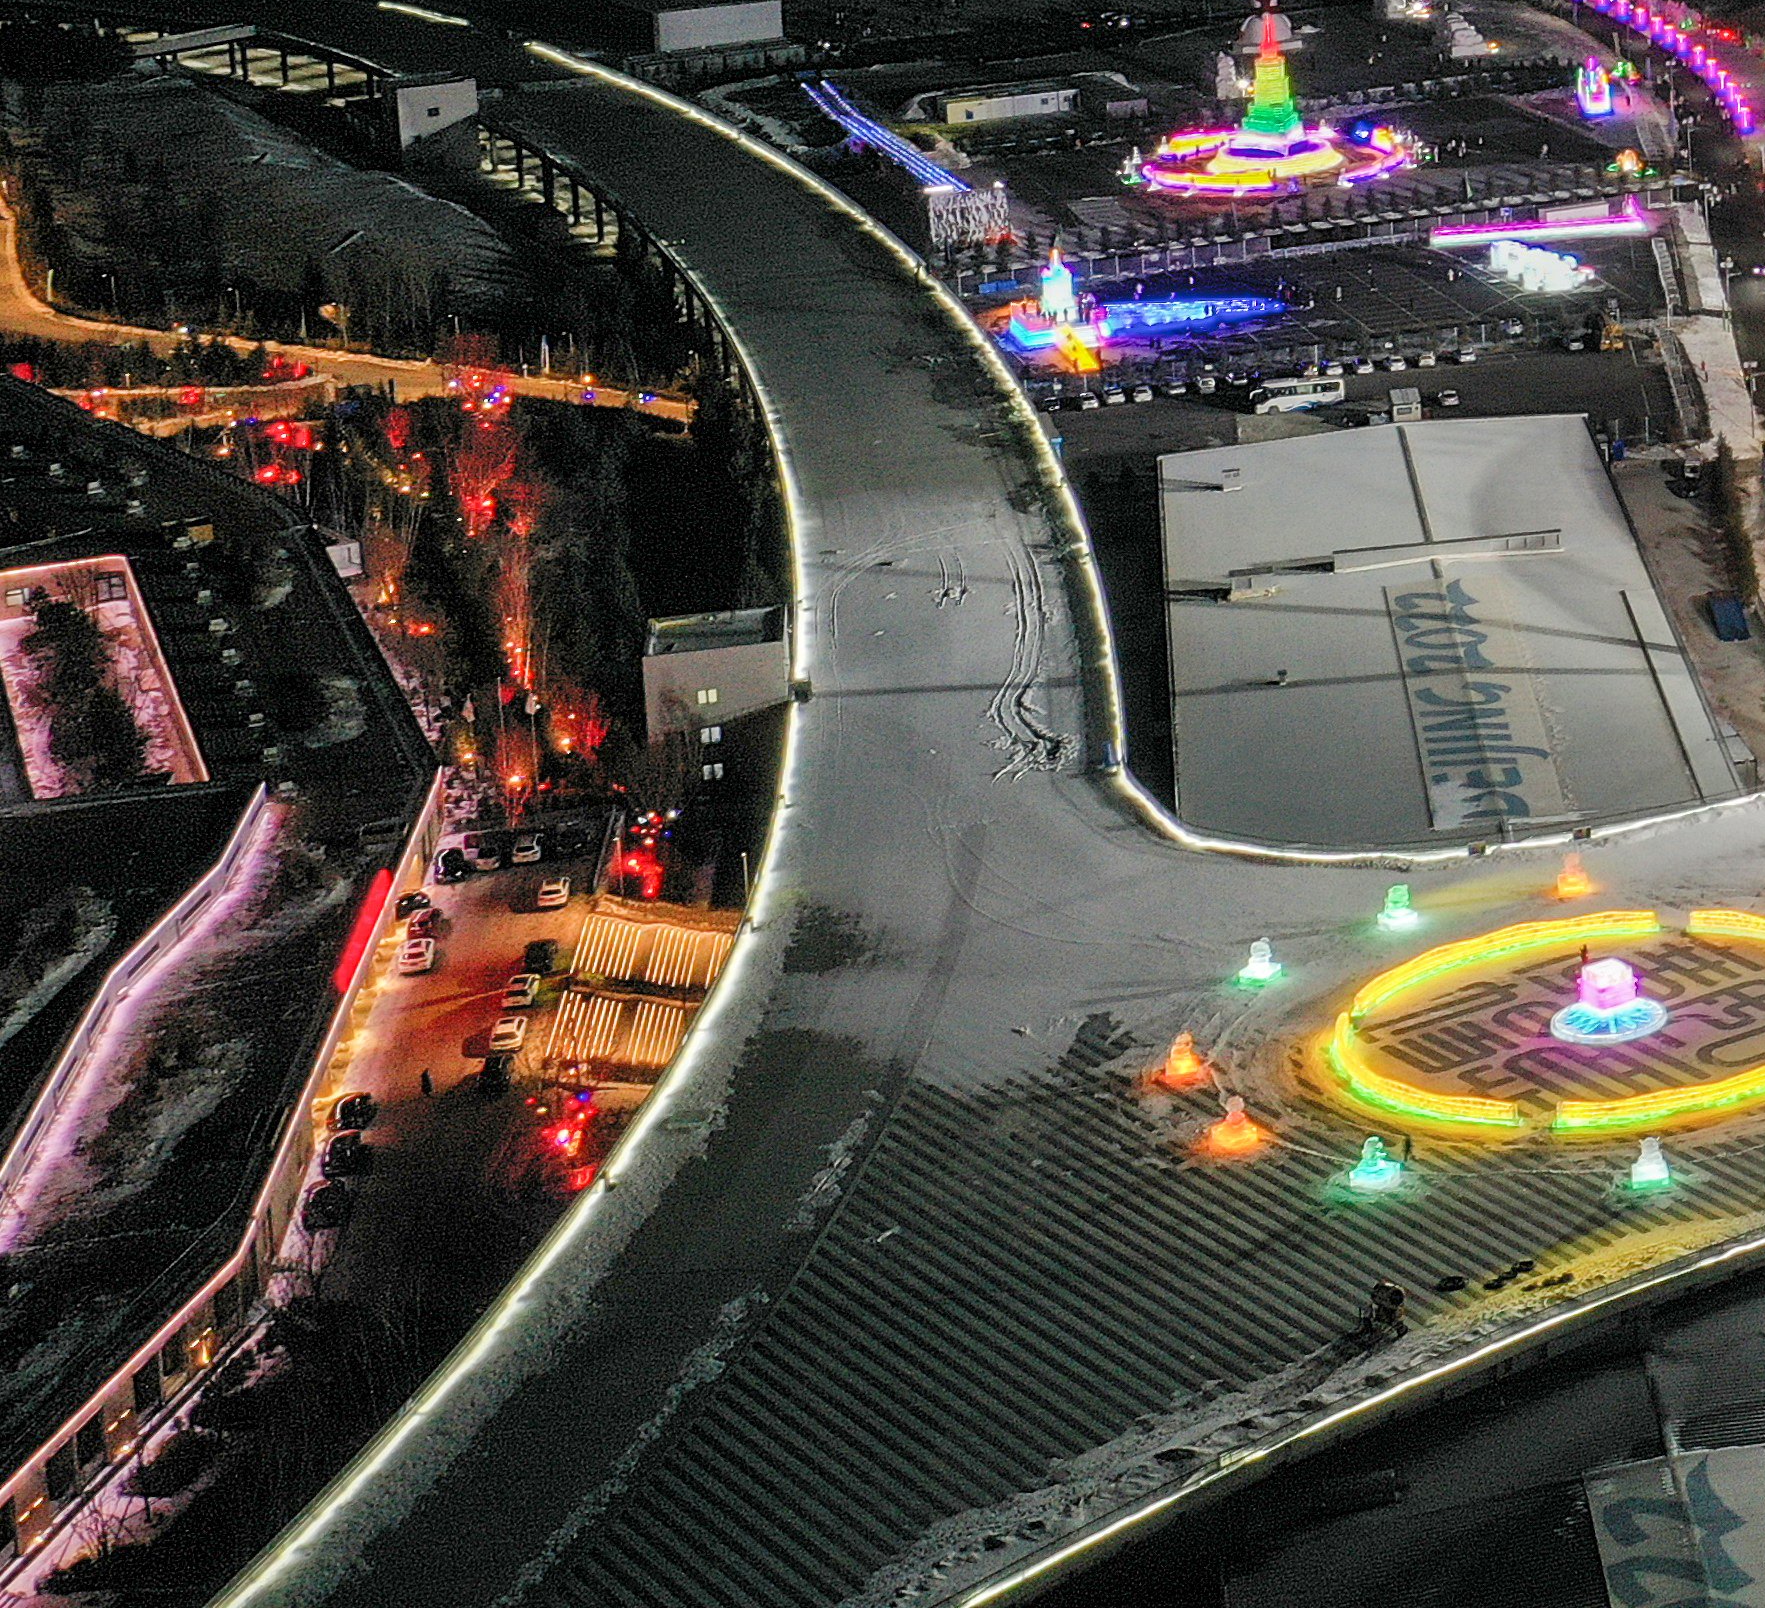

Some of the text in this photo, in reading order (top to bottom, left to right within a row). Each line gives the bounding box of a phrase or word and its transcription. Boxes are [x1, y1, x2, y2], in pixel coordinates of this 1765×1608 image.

[1394, 578, 1550, 819] BEIJING 2022
[1603, 1455, 1756, 1608] 22
